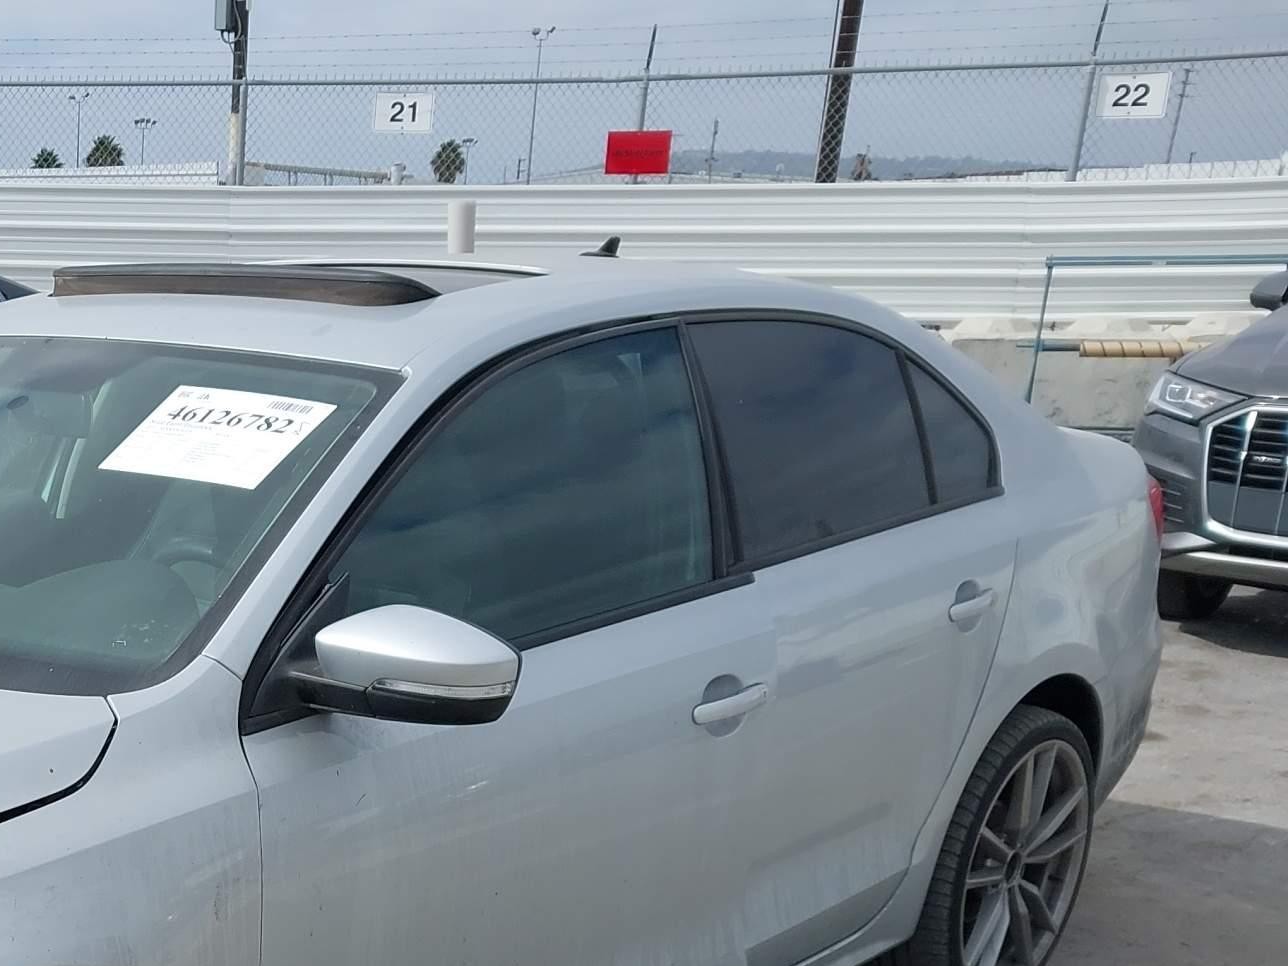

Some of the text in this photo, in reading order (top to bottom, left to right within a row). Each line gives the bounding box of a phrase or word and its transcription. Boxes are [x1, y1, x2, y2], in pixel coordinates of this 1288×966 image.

[1112, 83, 1151, 108] 22
[389, 101, 418, 123] 21
[167, 405, 295, 434] 46126782
